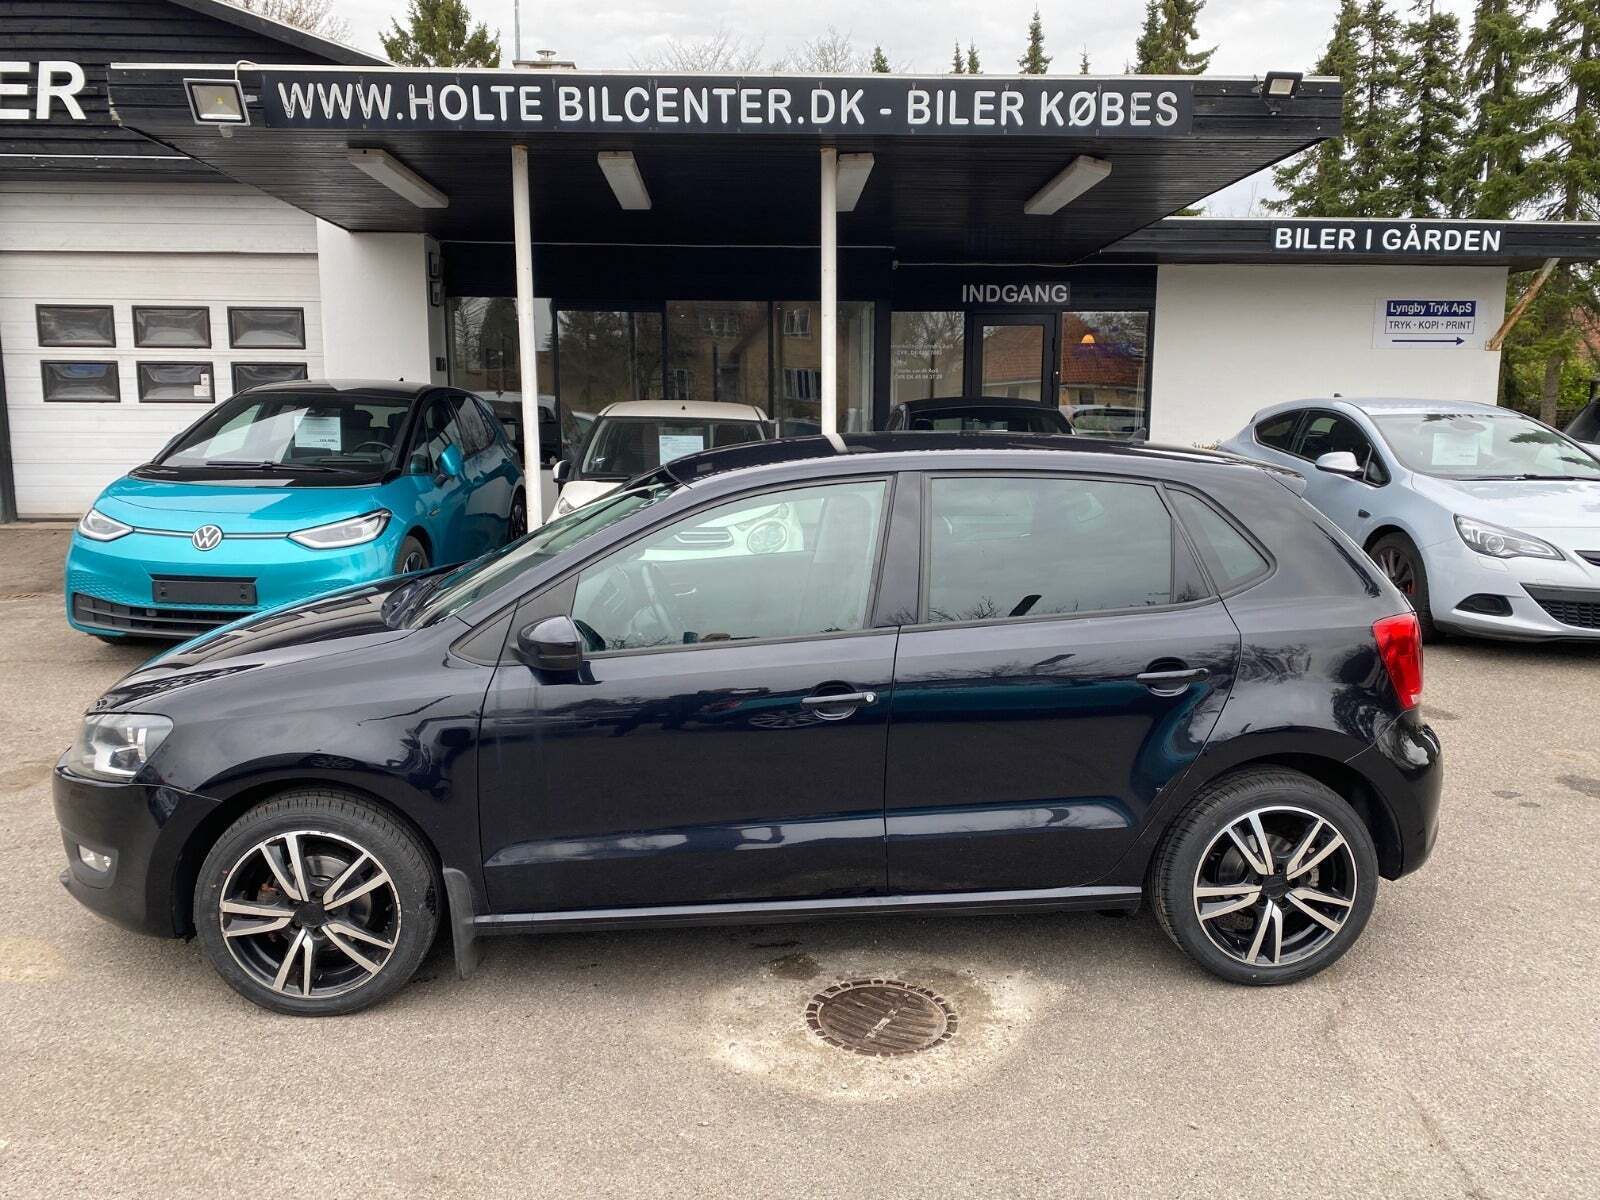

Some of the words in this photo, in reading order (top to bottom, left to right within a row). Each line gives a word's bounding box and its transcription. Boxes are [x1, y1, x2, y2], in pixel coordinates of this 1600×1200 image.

[277, 82, 543, 122] WWW.HOLTE
[558, 86, 865, 125] BILCENTER.DK
[907, 90, 1025, 126] BILER
[1040, 89, 1179, 127] KØBES
[1275, 227, 1356, 250] BILER
[1365, 228, 1372, 250] I
[1382, 223, 1502, 252] GÅRDEN
[962, 284, 1069, 303] INDGANG
[1390, 302, 1426, 315] Lyngby
[1429, 302, 1450, 315] Tryk
[1451, 302, 1472, 315] ApS
[1389, 321, 1411, 329] TRYK
[1419, 321, 1439, 329] KOPI
[1446, 321, 1471, 329] PRINT
